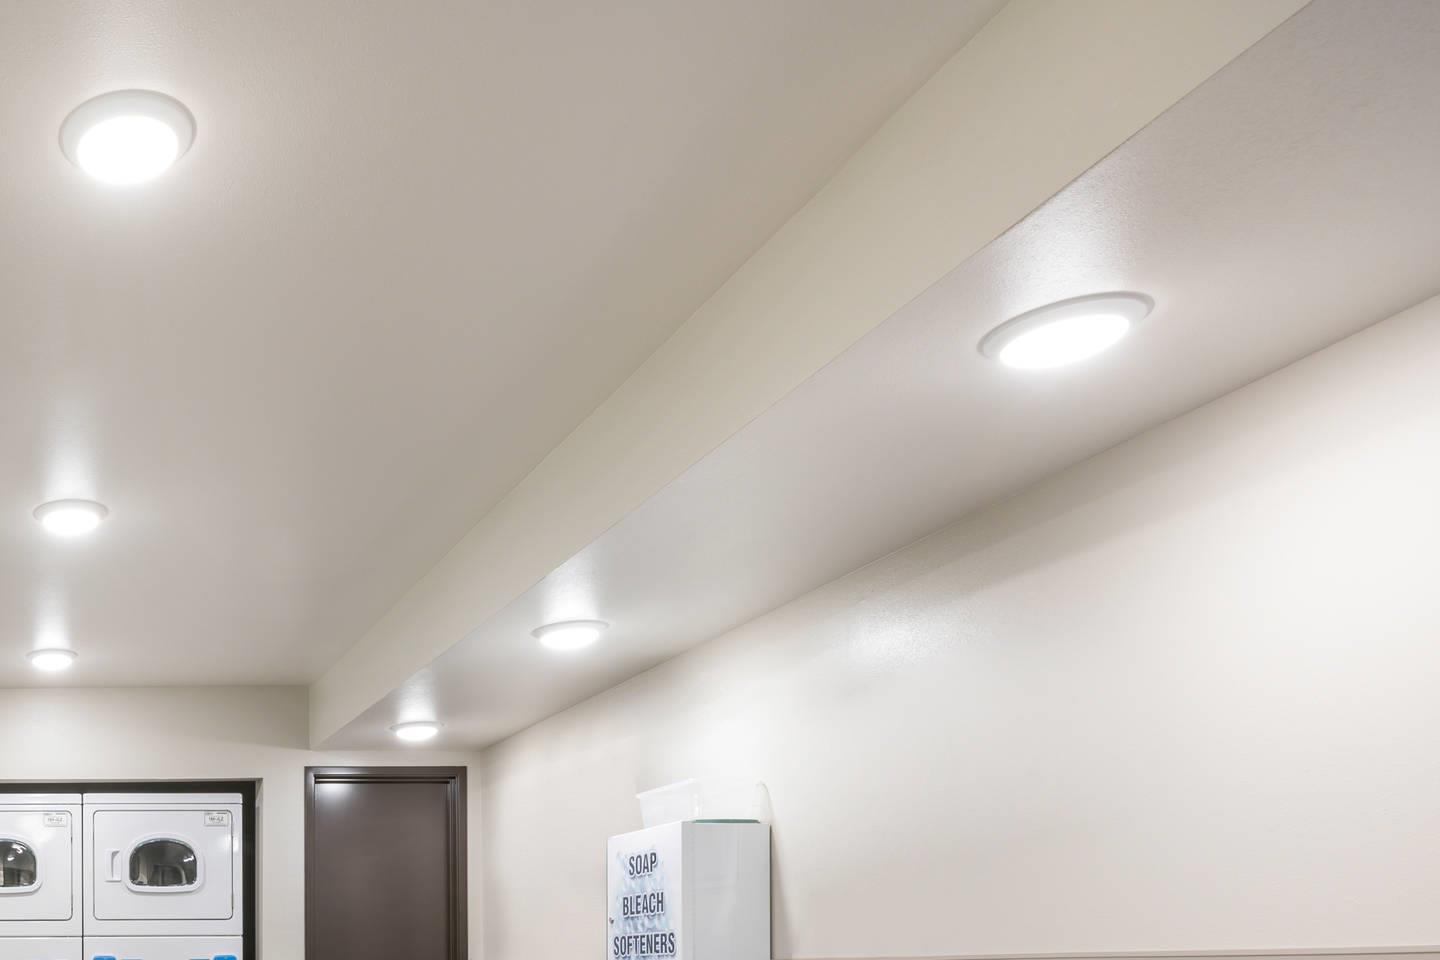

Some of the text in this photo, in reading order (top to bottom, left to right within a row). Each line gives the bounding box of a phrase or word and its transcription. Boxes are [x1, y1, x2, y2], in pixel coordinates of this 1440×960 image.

[628, 851, 657, 876] SOAP
[622, 891, 665, 916] BLEACH
[613, 932, 676, 956] SOFTENERS
